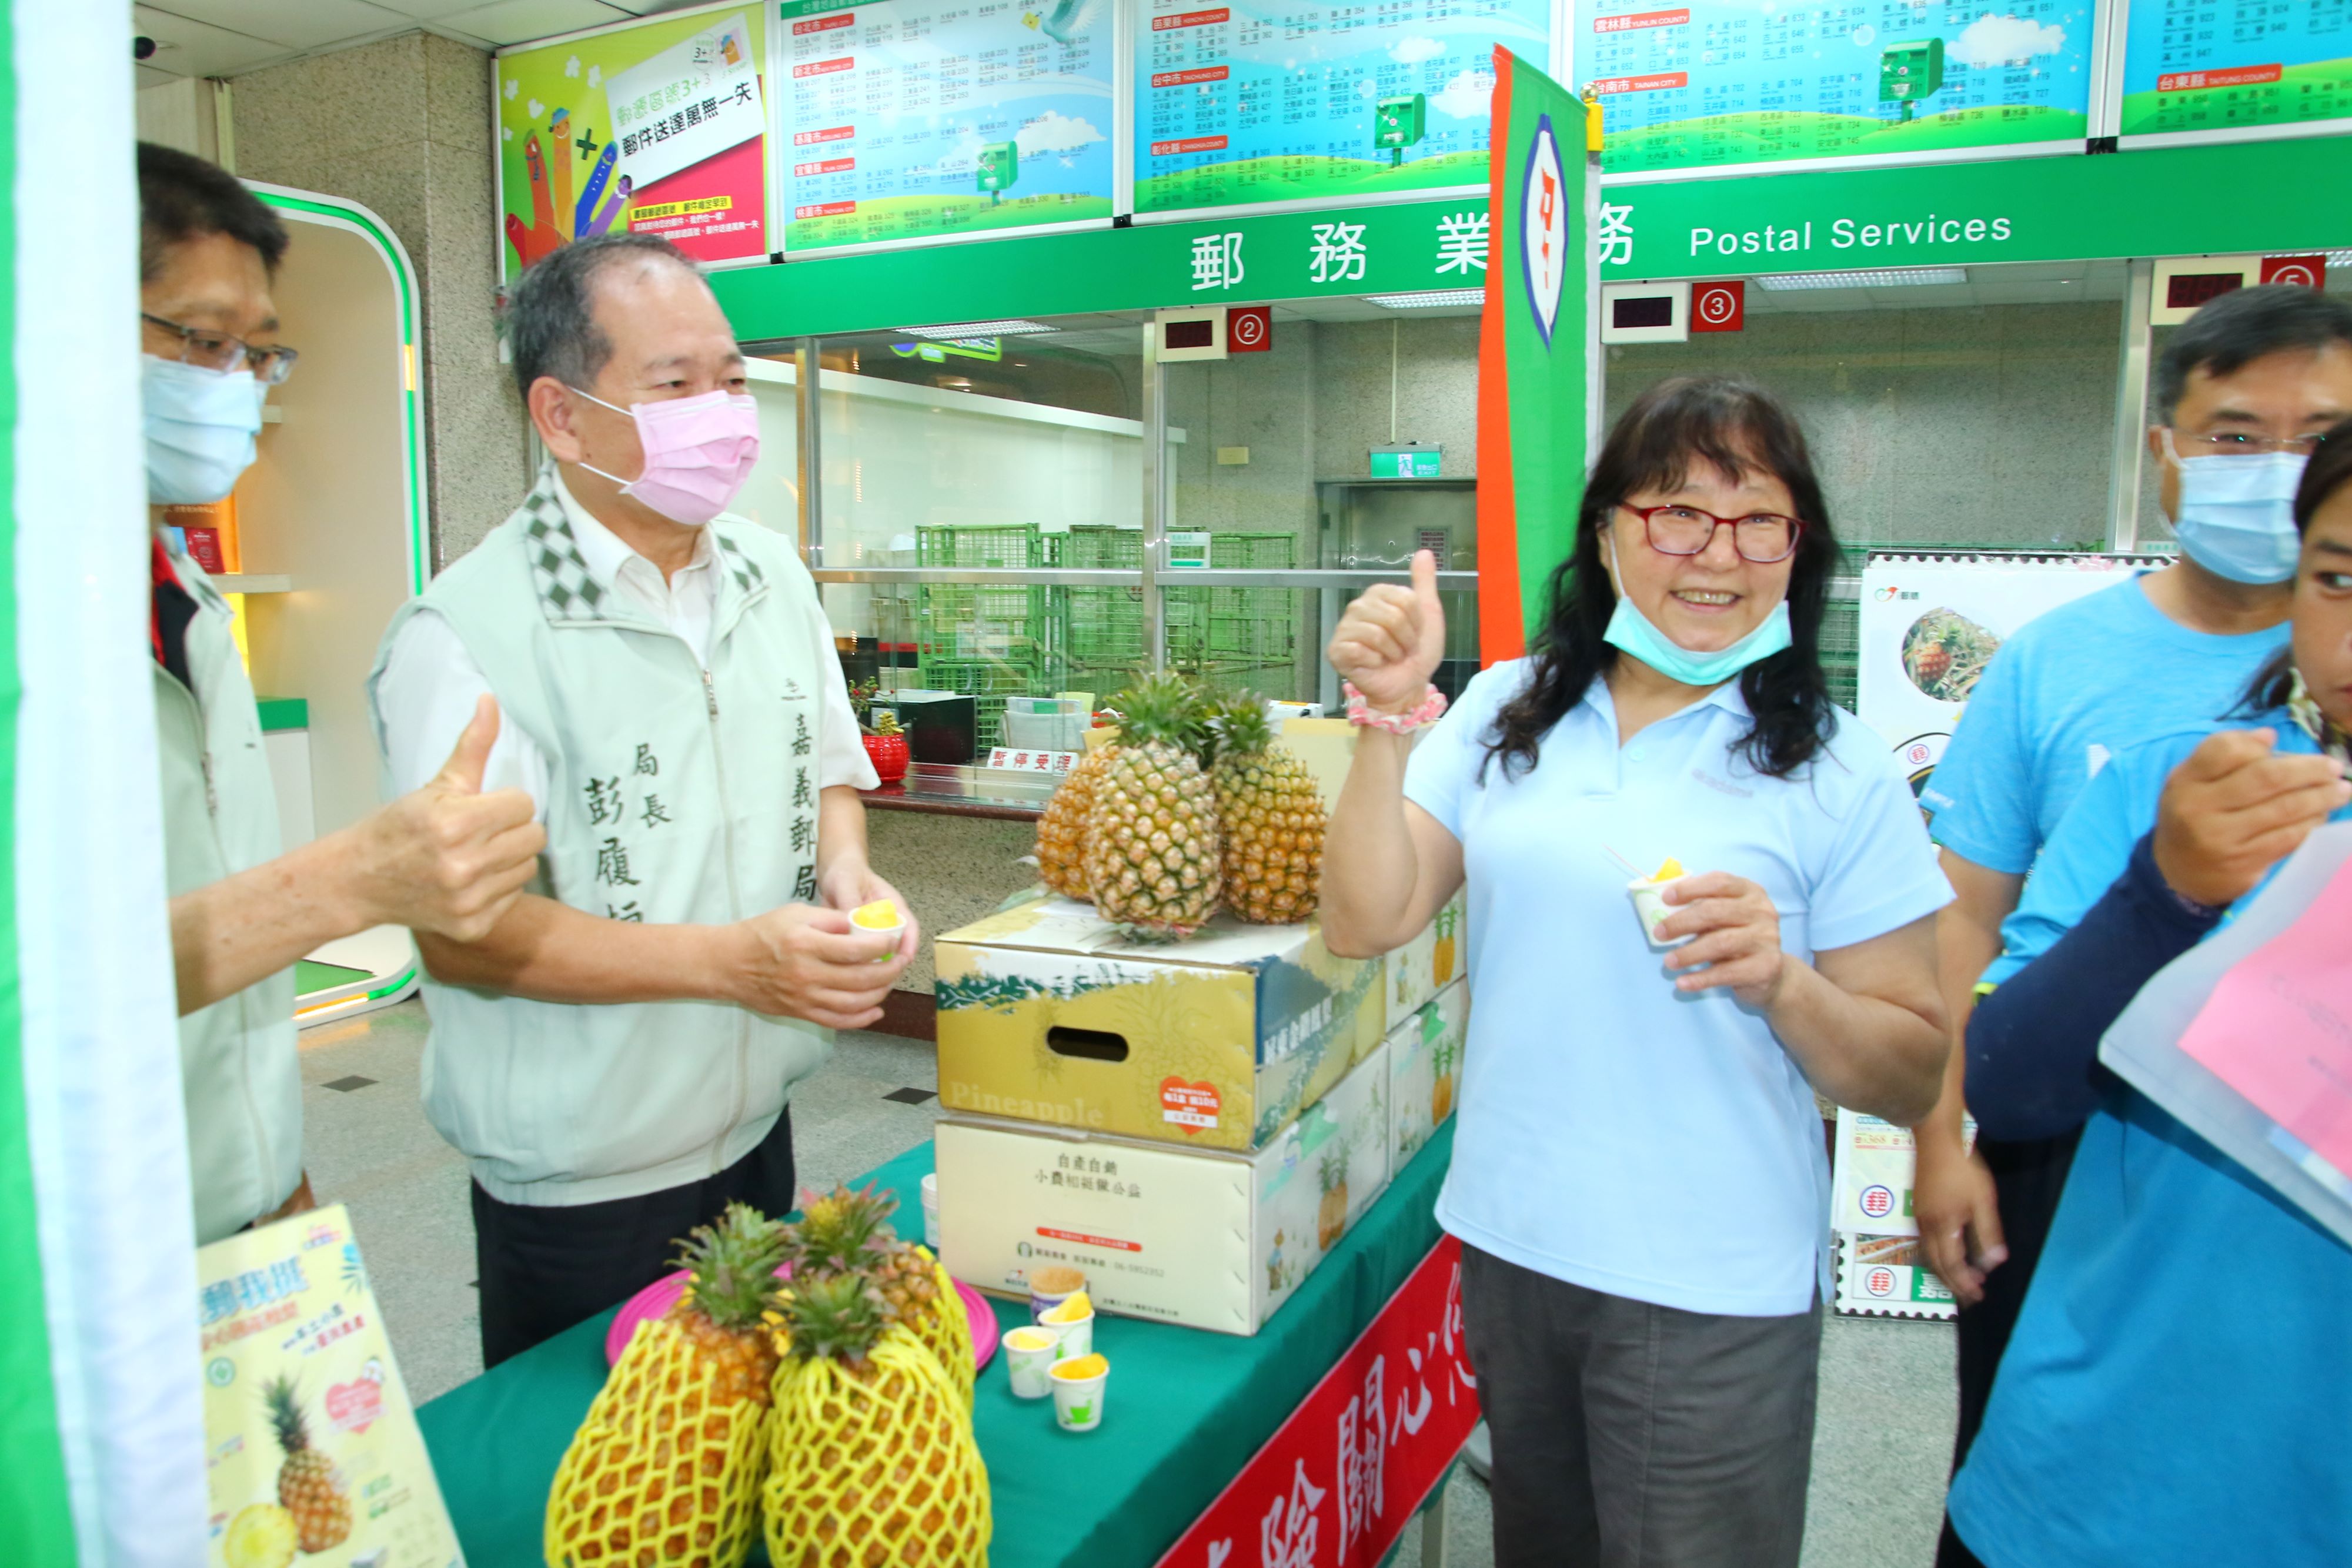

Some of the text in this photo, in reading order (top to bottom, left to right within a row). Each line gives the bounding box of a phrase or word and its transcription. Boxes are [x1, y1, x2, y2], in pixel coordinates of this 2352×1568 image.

[794, 21, 821, 34] 台北市
[1595, 15, 1688, 32] 雲林縣 YUNLIN COUNTY
[794, 64, 821, 76] 新北市
[1153, 72, 1181, 86] 台中市
[1596, 80, 1629, 93] 台南市
[2159, 74, 2206, 91] 台東縣
[796, 206, 823, 219] 桃園市
[1690, 214, 2012, 256] Postal Services
[1710, 297, 1725, 316] 3
[1242, 321, 1255, 338] 2
[993, 751, 1072, 771] 暫停受理
[633, 743, 672, 829] 局長
[790, 713, 818, 901] 嘉義郵局
[950, 1081, 1105, 1124] Pineapple
